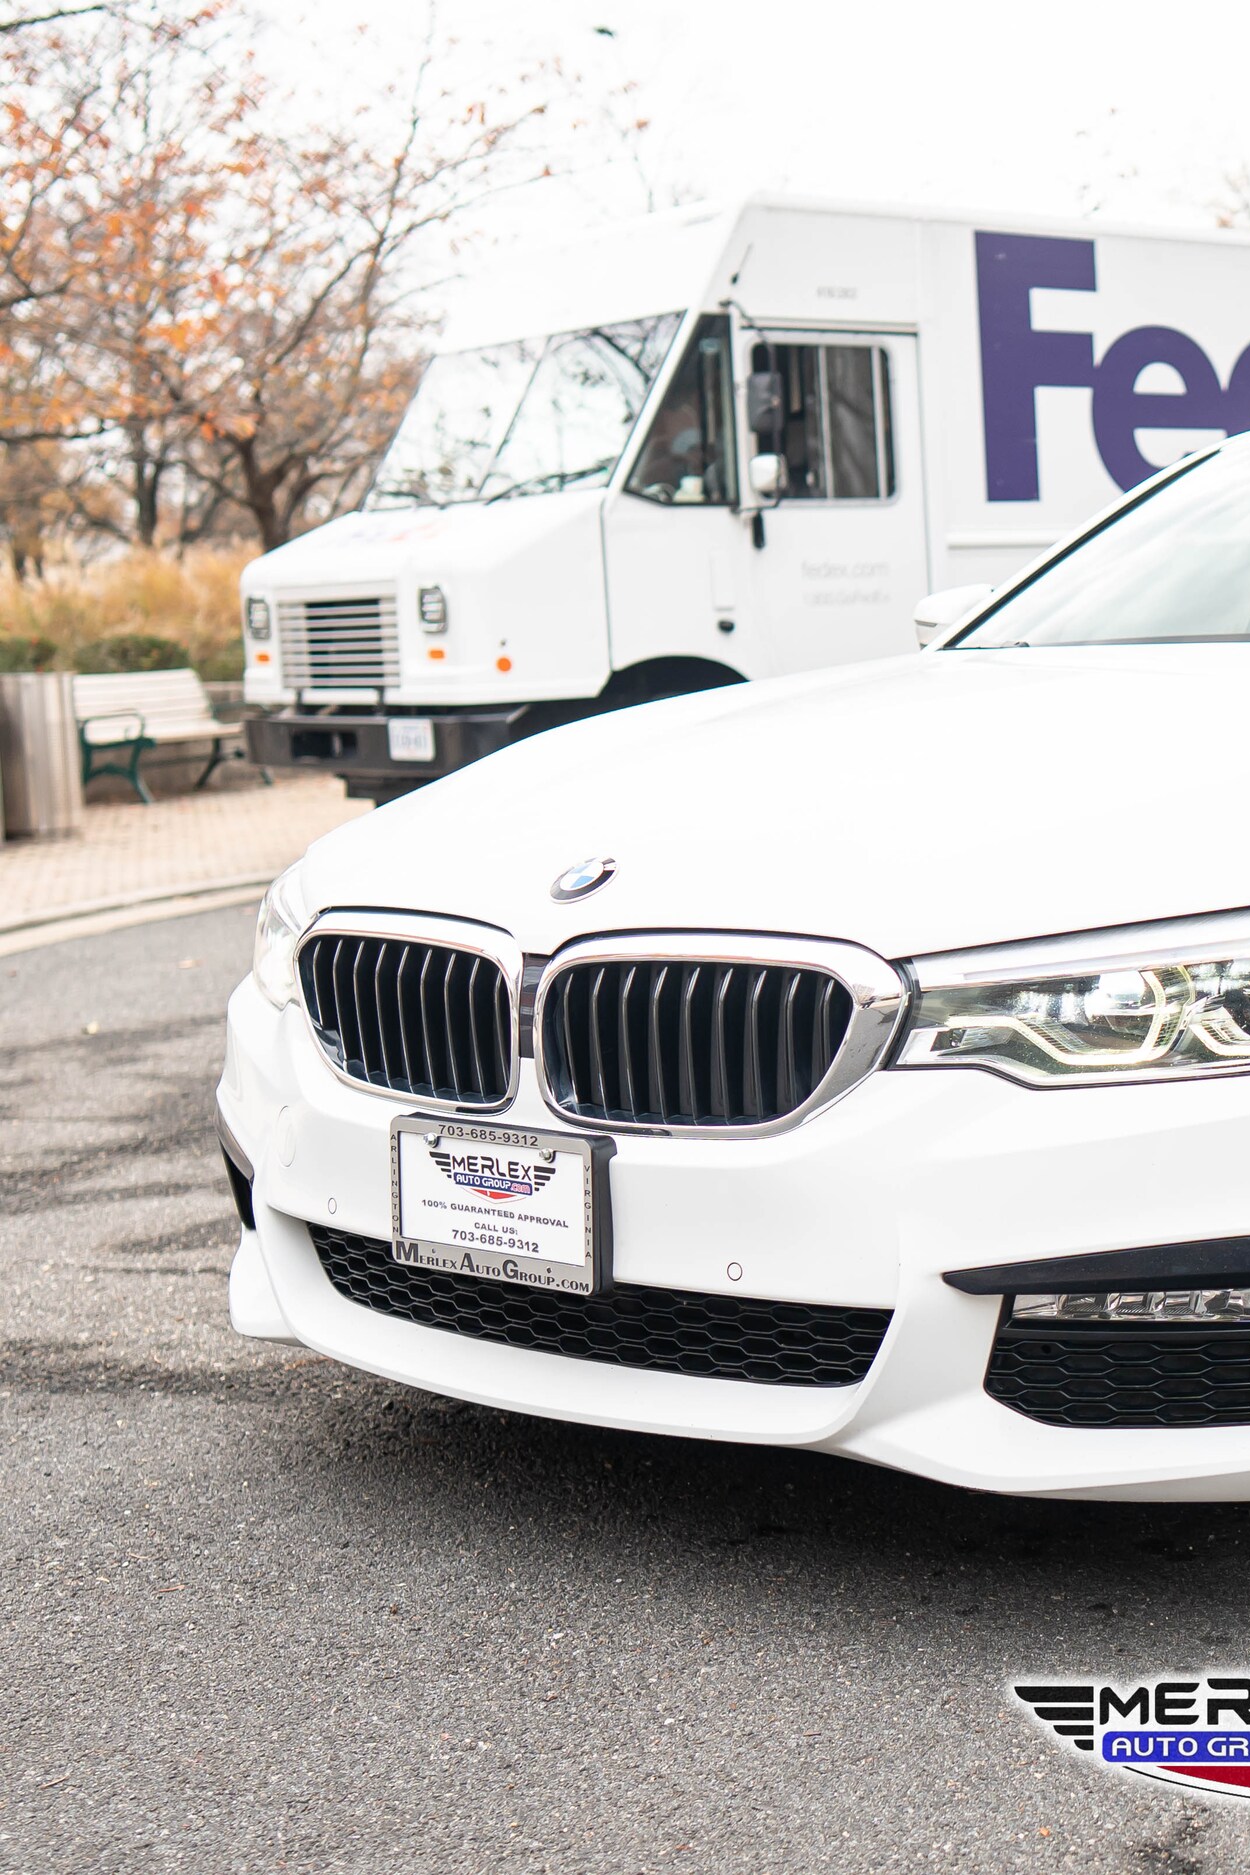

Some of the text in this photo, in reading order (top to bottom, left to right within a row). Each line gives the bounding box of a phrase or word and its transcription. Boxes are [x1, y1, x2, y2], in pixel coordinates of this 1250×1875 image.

[438, 1124, 539, 1147] 703-685-9312
[451, 1155, 531, 1181] MERLEX
[456, 1174, 480, 1185] AUTO
[390, 1133, 399, 1234] ARLINGTON
[421, 1199, 569, 1228] 100% GUARANTEED APPROVAL
[584, 1164, 592, 1259] VIRGINIA
[474, 1222, 498, 1232] CALL
[452, 1229, 539, 1253] 703-685-9312
